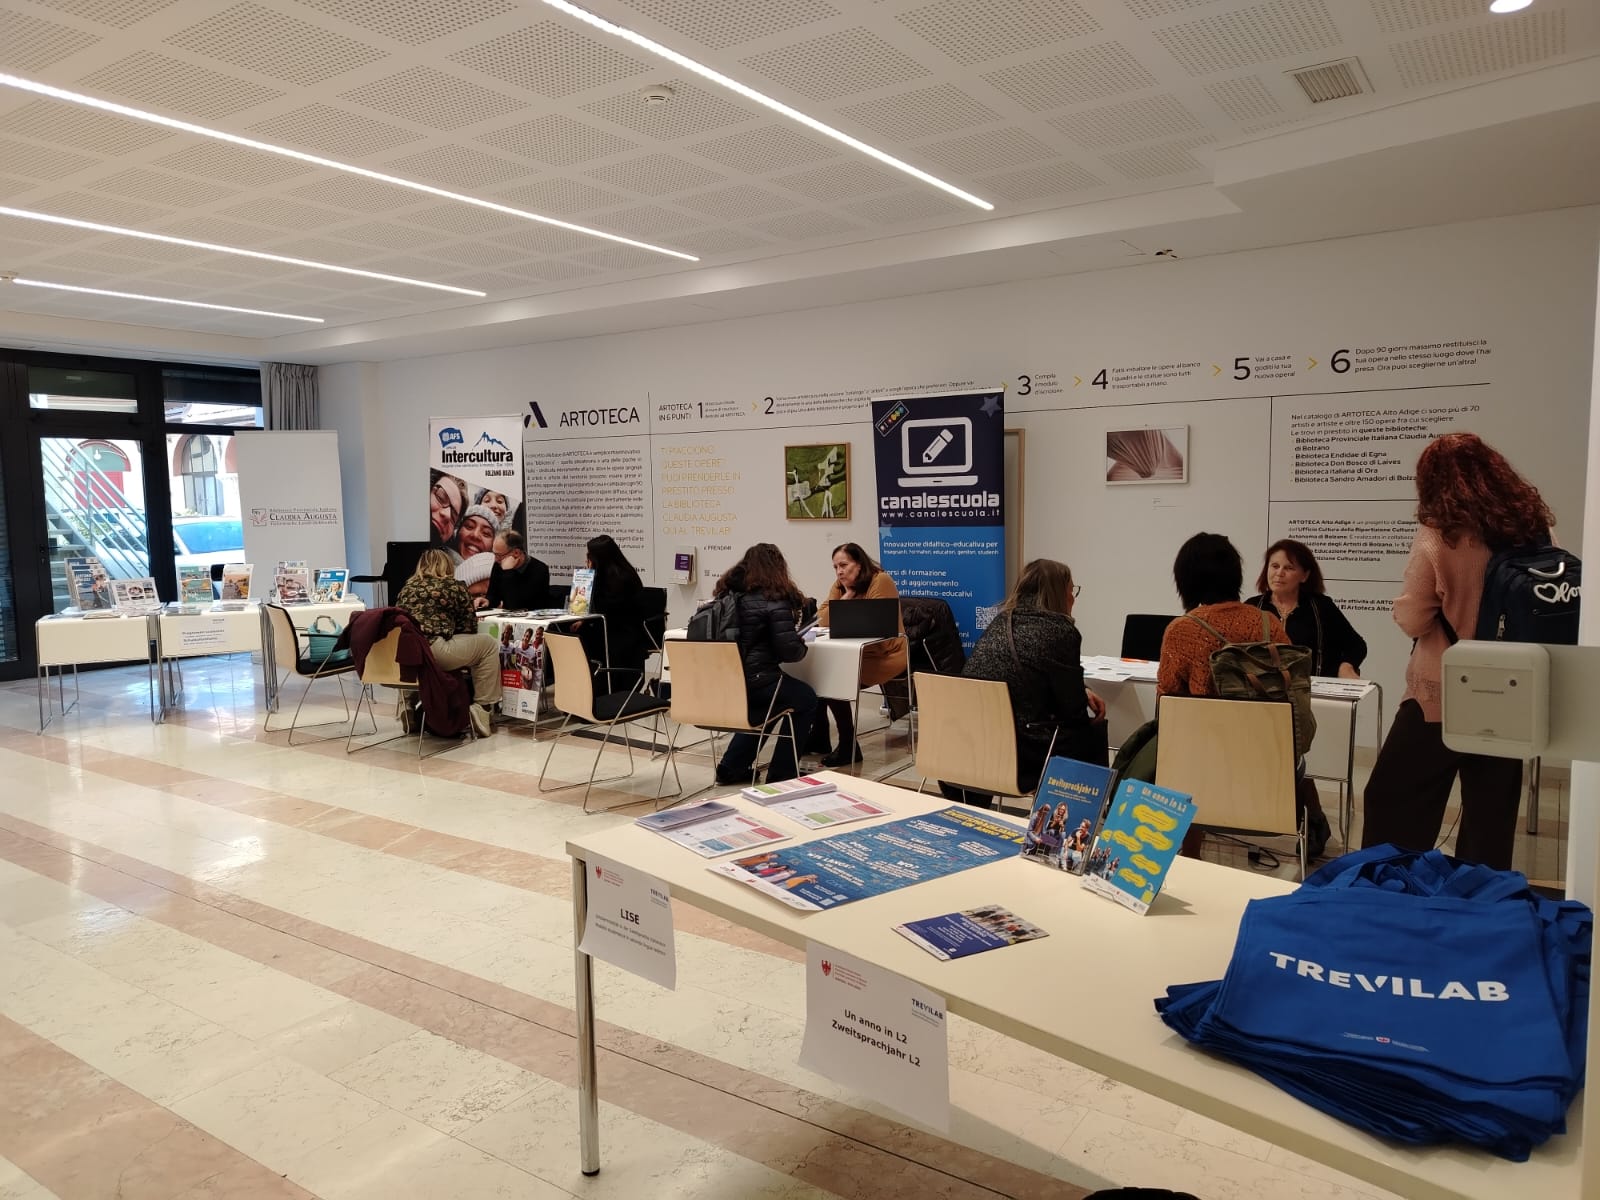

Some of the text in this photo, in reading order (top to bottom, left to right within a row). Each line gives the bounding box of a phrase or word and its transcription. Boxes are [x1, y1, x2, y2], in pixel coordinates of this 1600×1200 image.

[1234, 357, 1250, 380] 5
[1330, 349, 1350, 374] 6
[1409, 361, 1446, 369] sceglierne
[1017, 375, 1031, 395] 3
[1092, 368, 1108, 390] 4
[659, 403, 692, 412] ARTOTECA
[698, 402, 703, 419] 1
[764, 397, 774, 414] 2
[560, 407, 640, 427] ARTOTECA
[442, 449, 513, 463] Intercultura
[682, 472, 730, 481] PRENDERLE
[733, 472, 741, 480] IN
[662, 486, 735, 496] PRESTITO PRESSO
[881, 490, 1000, 509] canalescuola
[663, 499, 721, 508] LA BIBLIOTECA
[662, 512, 738, 521] CLAUDIA AUGUSTA
[882, 509, 1000, 518] www.canalescuola.it
[620, 908, 640, 925] LISE
[1268, 951, 1510, 1002] TREVILAB
[912, 998, 943, 1020] TREVILAB
[844, 1009, 907, 1044] Un anno in L2
[832, 1019, 921, 1067] Zweitsprachjahr L2
